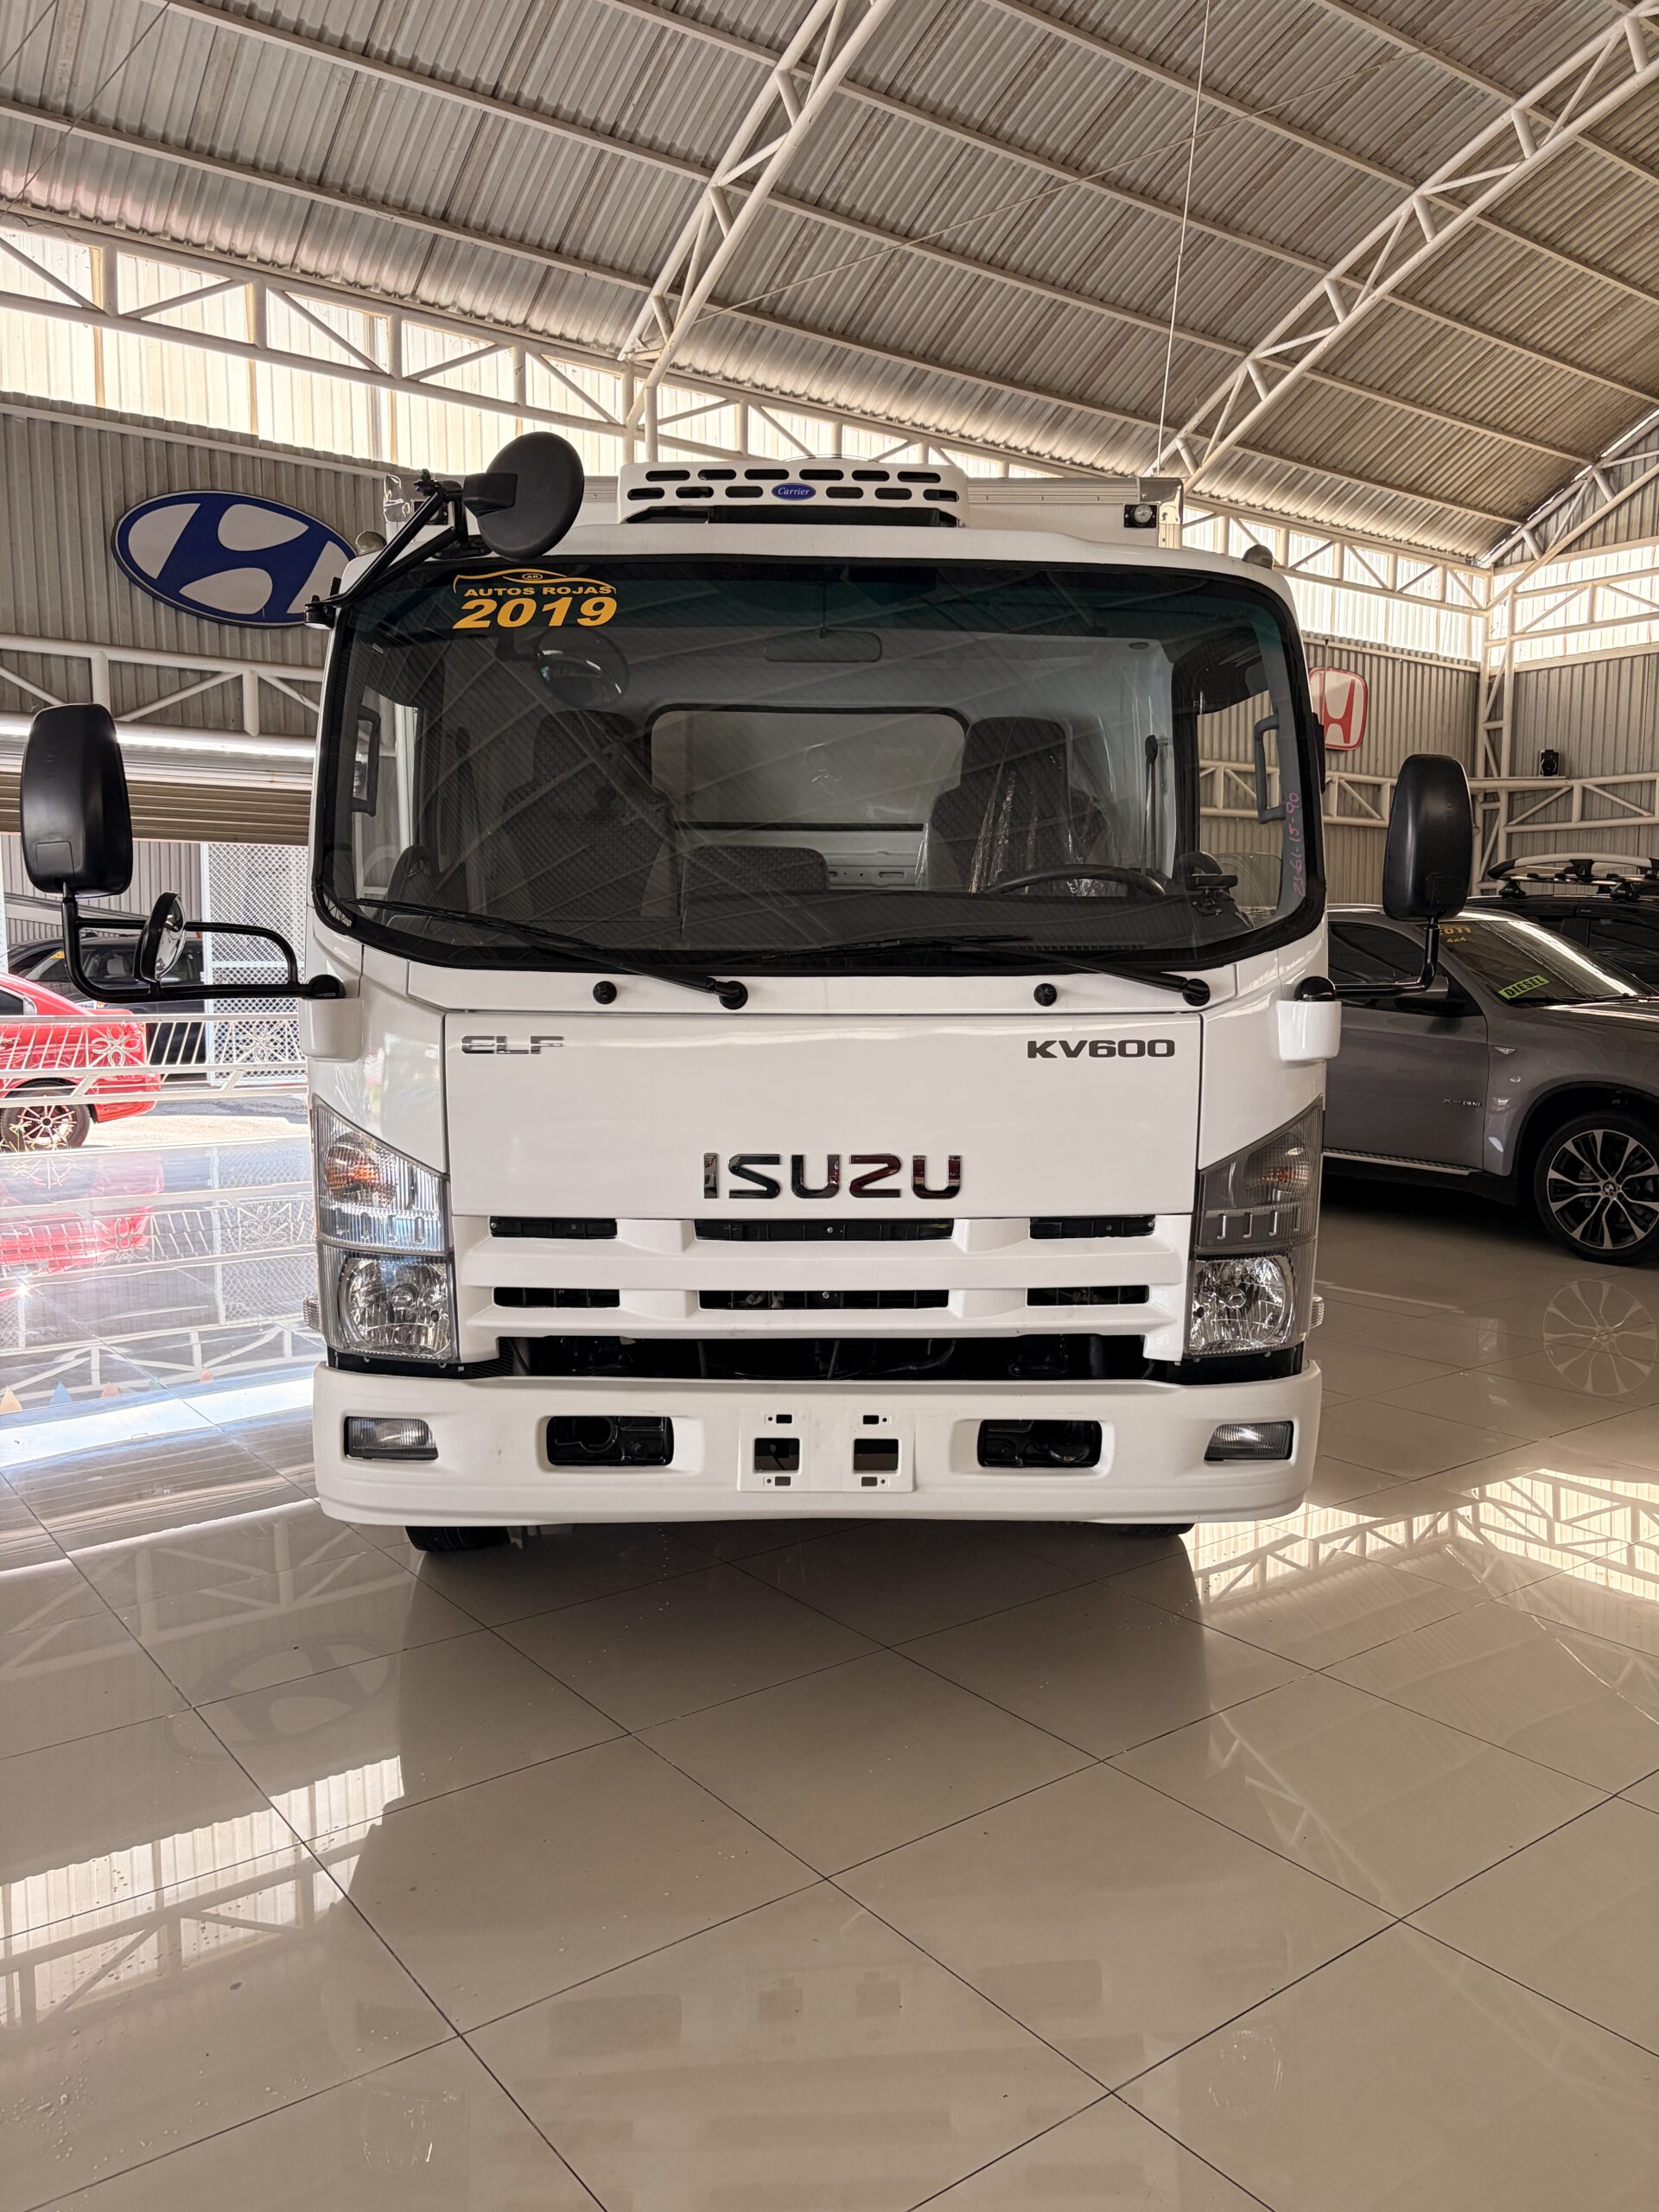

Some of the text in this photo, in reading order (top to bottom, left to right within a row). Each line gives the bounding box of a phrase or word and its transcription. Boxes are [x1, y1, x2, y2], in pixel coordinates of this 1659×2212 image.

[778, 486, 810, 495] Carrier
[464, 586, 612, 597] AUTOS ROJAS
[452, 596, 617, 629] 2019
[1503, 977, 1545, 996] DIESEL
[461, 1035, 564, 1055] ELF
[1027, 1039, 1176, 1058] KV600
[702, 1152, 963, 1200] ISUZU
